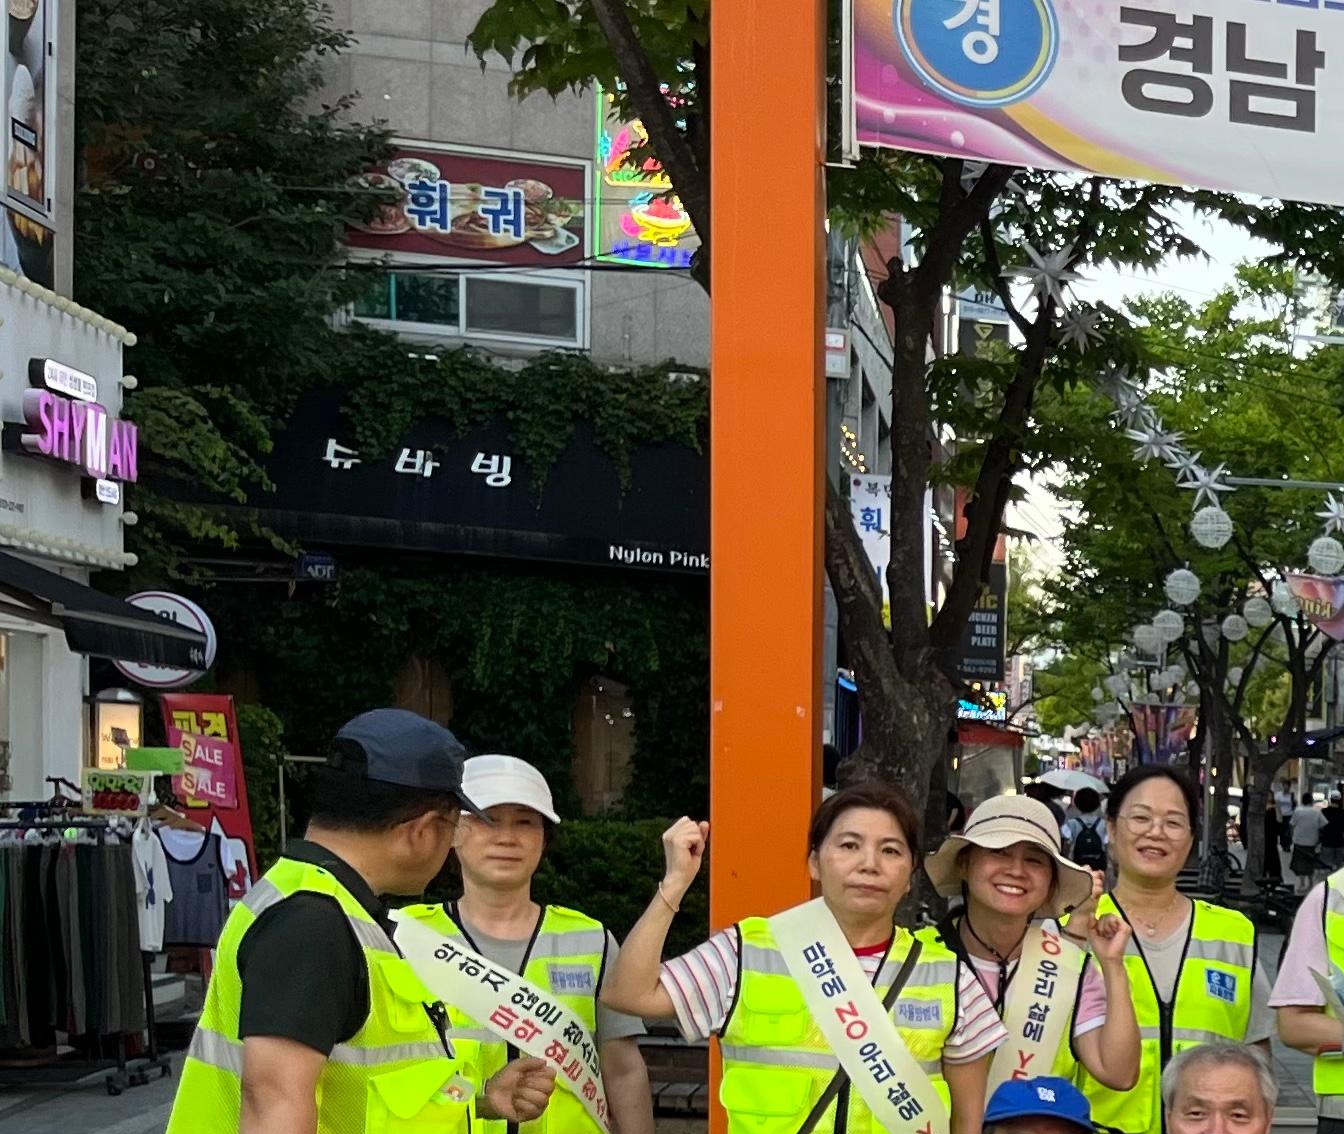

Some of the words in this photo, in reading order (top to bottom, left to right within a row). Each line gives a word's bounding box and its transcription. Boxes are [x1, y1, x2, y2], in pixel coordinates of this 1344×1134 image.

[1118, 8, 1325, 134] 경남
[406, 178, 525, 240] 훠궈
[37, 389, 138, 483] SHYMAN
[609, 545, 663, 567] Nylon
[670, 550, 710, 569] Pink
[182, 738, 224, 766] SALE
[434, 943, 510, 992] 약하지
[511, 987, 563, 1025] 않은
[1033, 959, 1058, 999] 우리
[489, 1005, 542, 1043] 마약
[545, 1039, 583, 1082] 없는
[802, 941, 847, 998] 마약에
[835, 1001, 868, 1040] NO
[859, 1042, 895, 1084] 우리
[887, 1082, 924, 1121] 삶에
[898, 1003, 940, 1022] 자율방범대
[1022, 1001, 1050, 1043] 삶에
